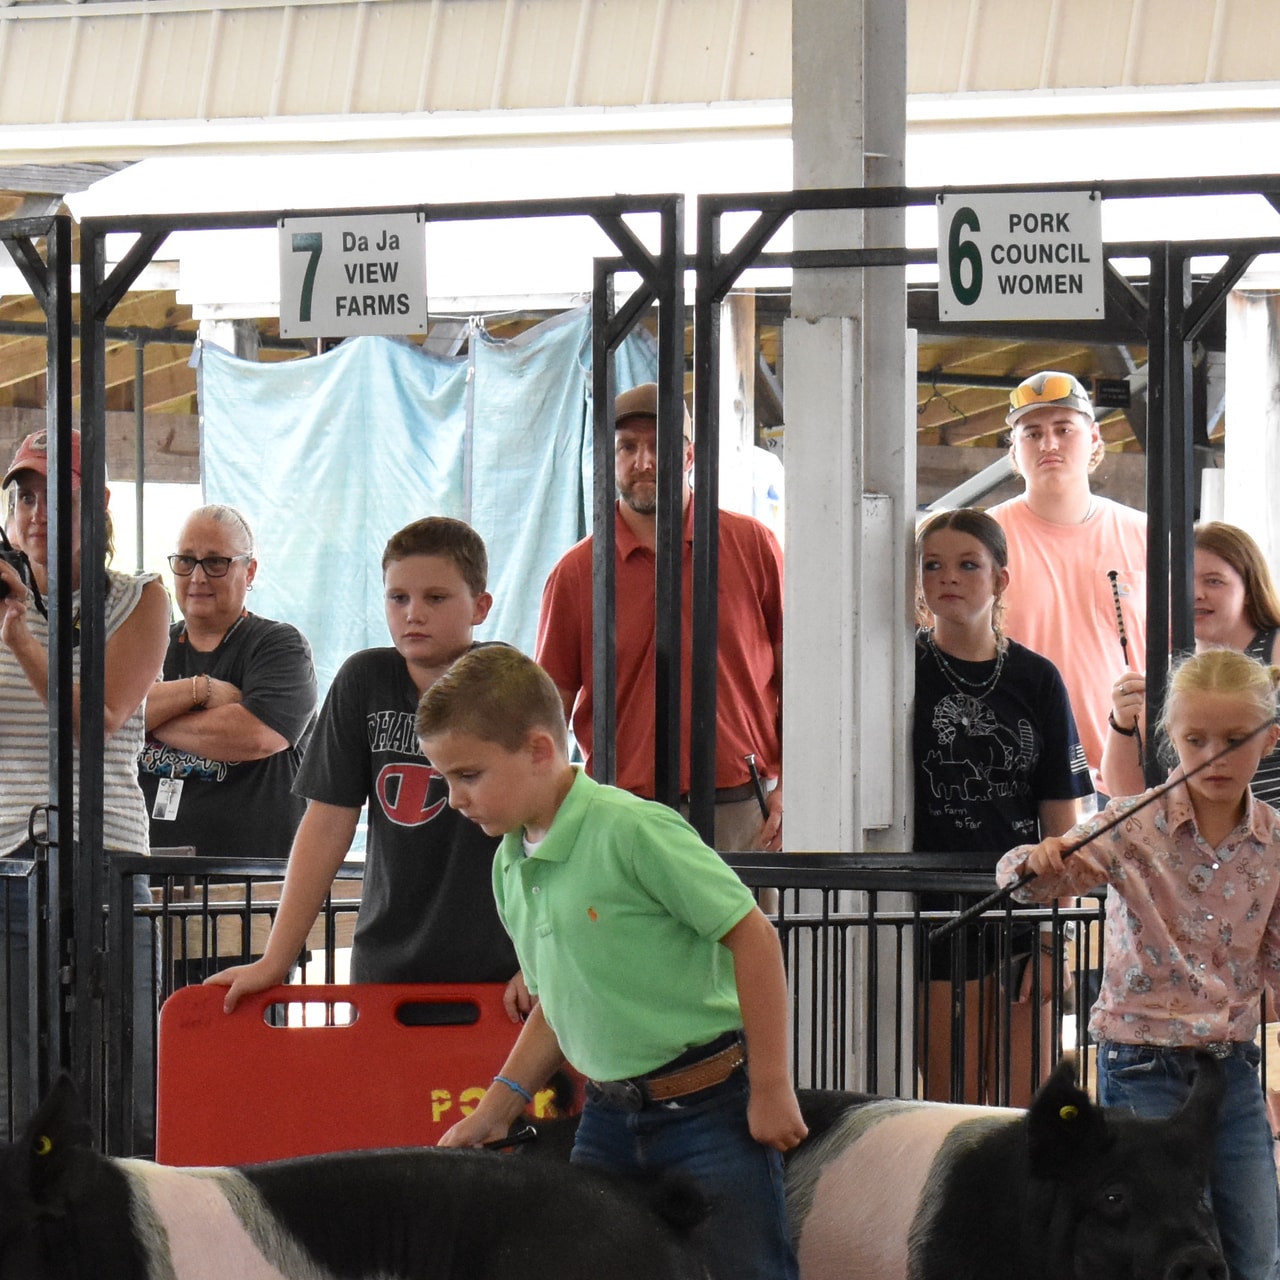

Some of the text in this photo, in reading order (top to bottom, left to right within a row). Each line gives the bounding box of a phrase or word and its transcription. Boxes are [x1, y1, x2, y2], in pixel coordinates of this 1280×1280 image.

[1009, 212, 1071, 234] PORK
[342, 229, 400, 252] Da Ja
[948, 206, 984, 306] 6
[990, 243, 1090, 265] COUNCIL
[291, 232, 323, 322] 7
[344, 261, 399, 284] VIEW
[997, 274, 1083, 295] WOMEN
[335, 293, 410, 317] FARMS
[431, 1086, 558, 1123] POK
